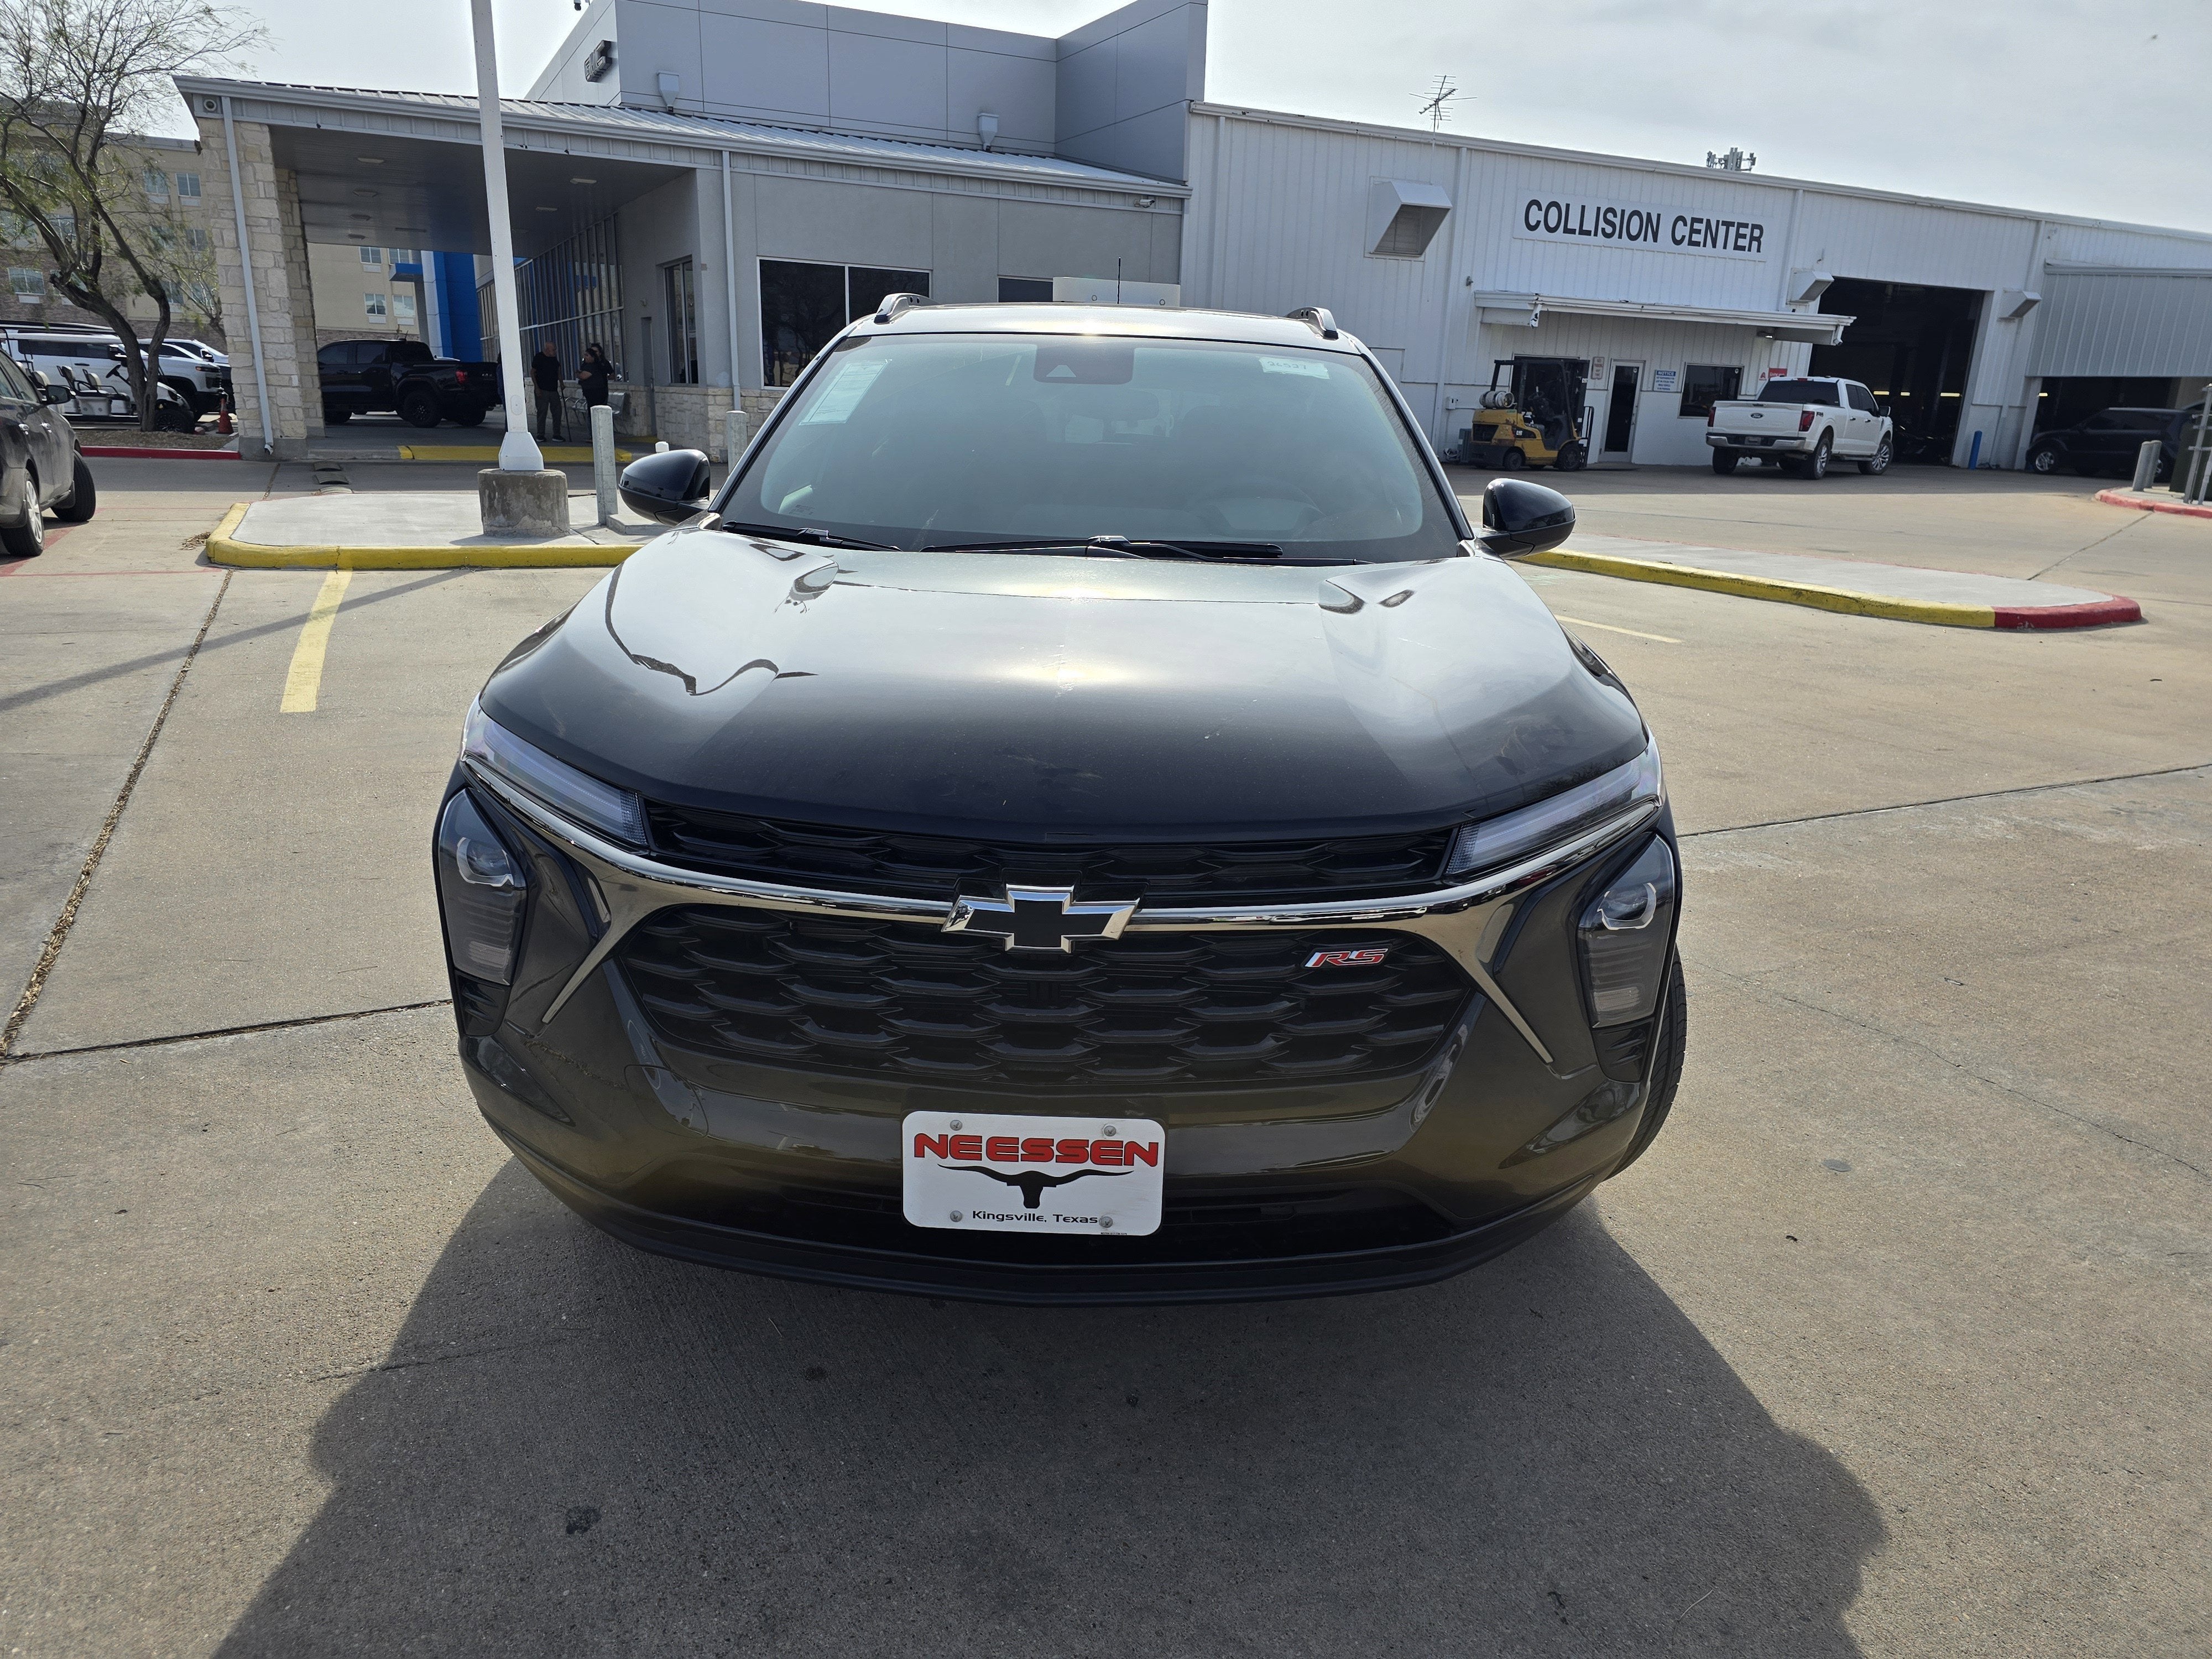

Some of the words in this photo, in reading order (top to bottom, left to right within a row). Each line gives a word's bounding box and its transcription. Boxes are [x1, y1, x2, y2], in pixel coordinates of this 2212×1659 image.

[1524, 199, 1662, 244] COLLISION
[1671, 215, 1764, 254] CENTER
[1305, 948, 1389, 968] RS
[914, 1133, 1159, 1167] NEESSEN
[972, 1210, 1047, 1223] Kingsville,
[1052, 1214, 1098, 1224] Texas
